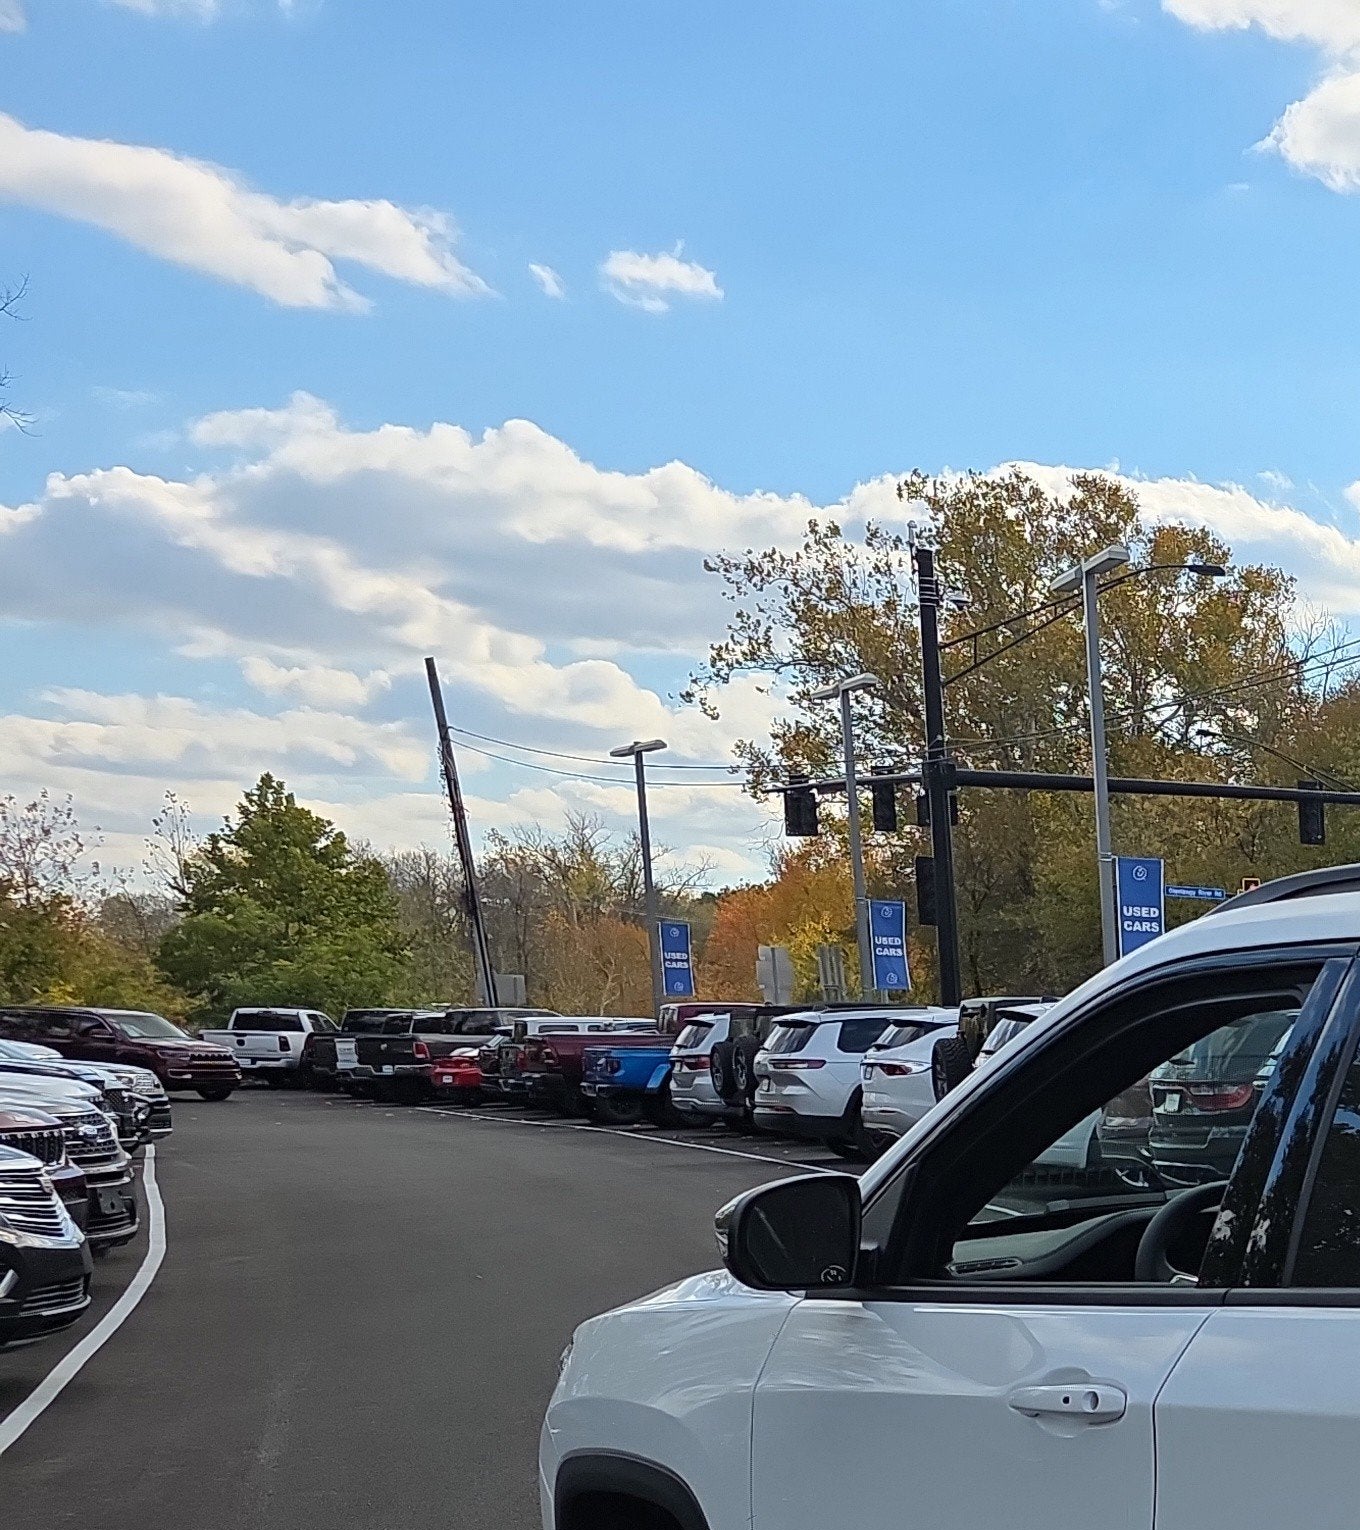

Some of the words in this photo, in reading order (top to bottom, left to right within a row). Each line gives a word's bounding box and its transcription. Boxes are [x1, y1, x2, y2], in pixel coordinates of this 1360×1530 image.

[1122, 905, 1160, 918] USED
[1123, 920, 1160, 933] CARS
[874, 935, 902, 946] USED
[664, 951, 688, 960] USED
[875, 947, 903, 957] CARS
[665, 960, 689, 969] CARS
